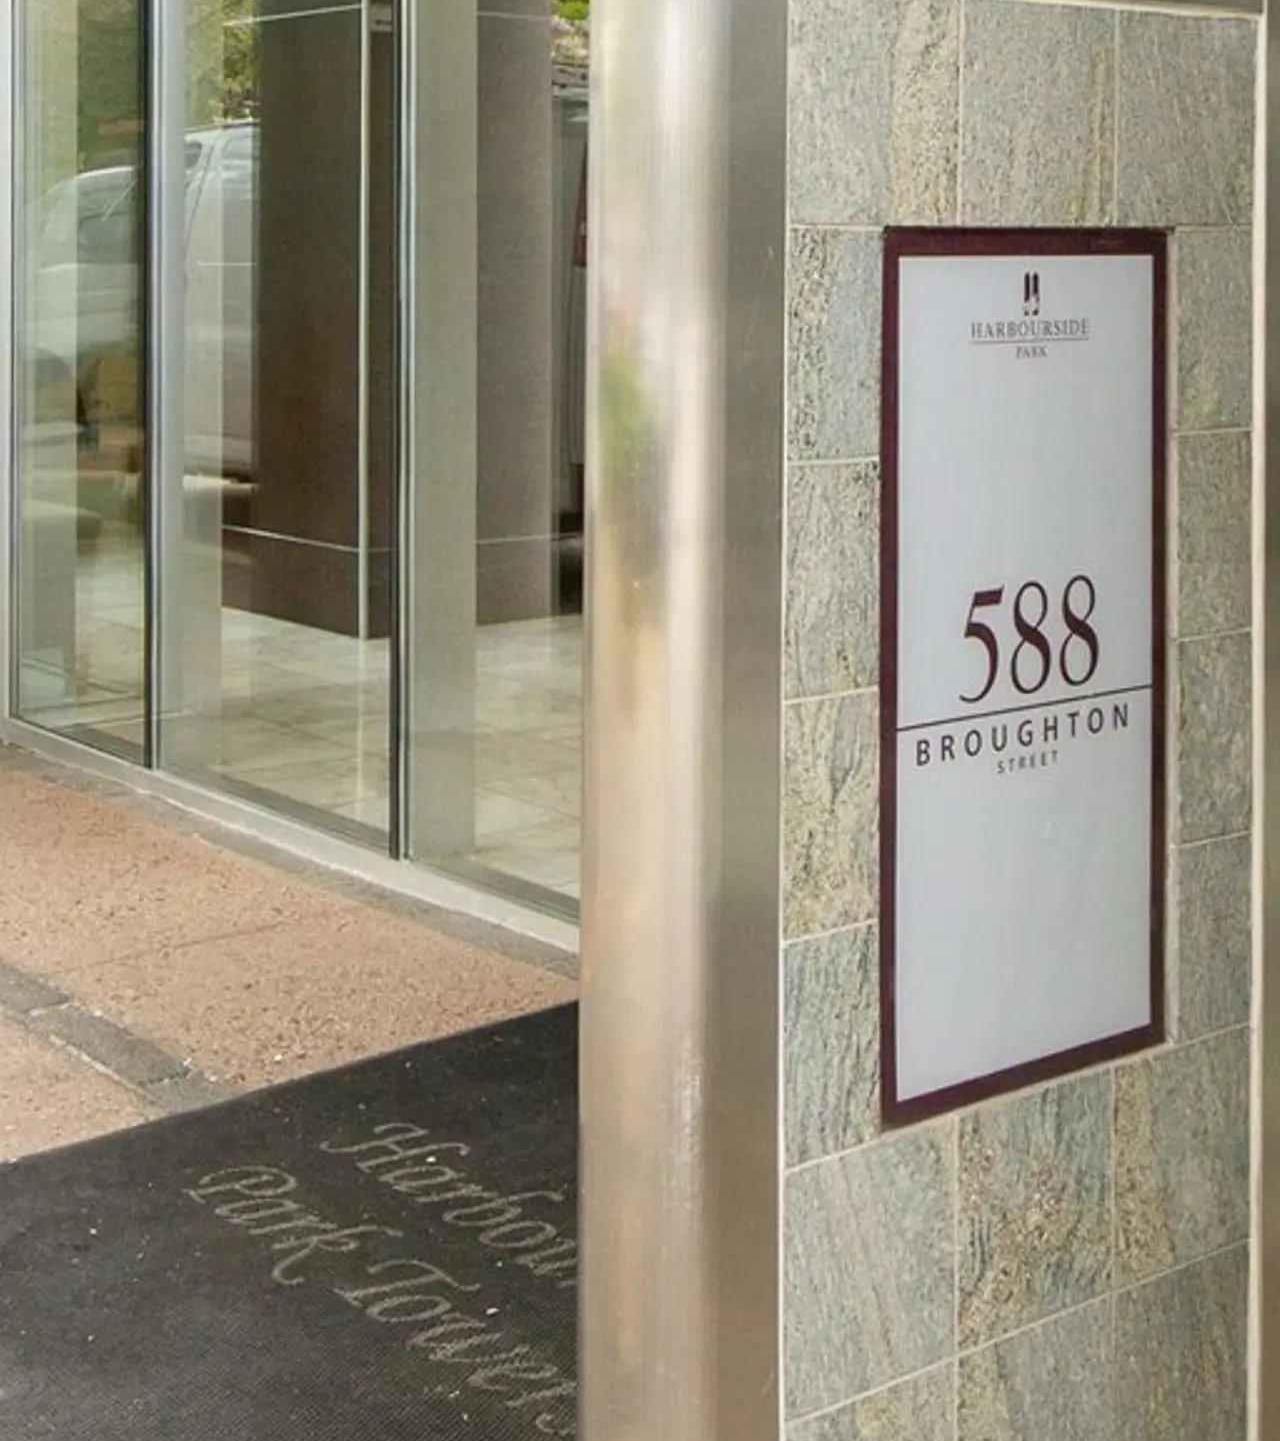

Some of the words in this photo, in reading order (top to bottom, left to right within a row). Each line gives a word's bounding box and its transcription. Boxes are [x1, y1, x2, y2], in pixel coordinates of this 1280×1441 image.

[970, 317, 1090, 339] HARBOURSIDE
[1016, 345, 1048, 359] PARK
[958, 574, 1100, 704] 588
[915, 702, 1129, 767] BROUGHTON
[996, 749, 1059, 775] STREET
[182, 1165, 404, 1286] Park
[321, 1122, 578, 1287] Harbou
